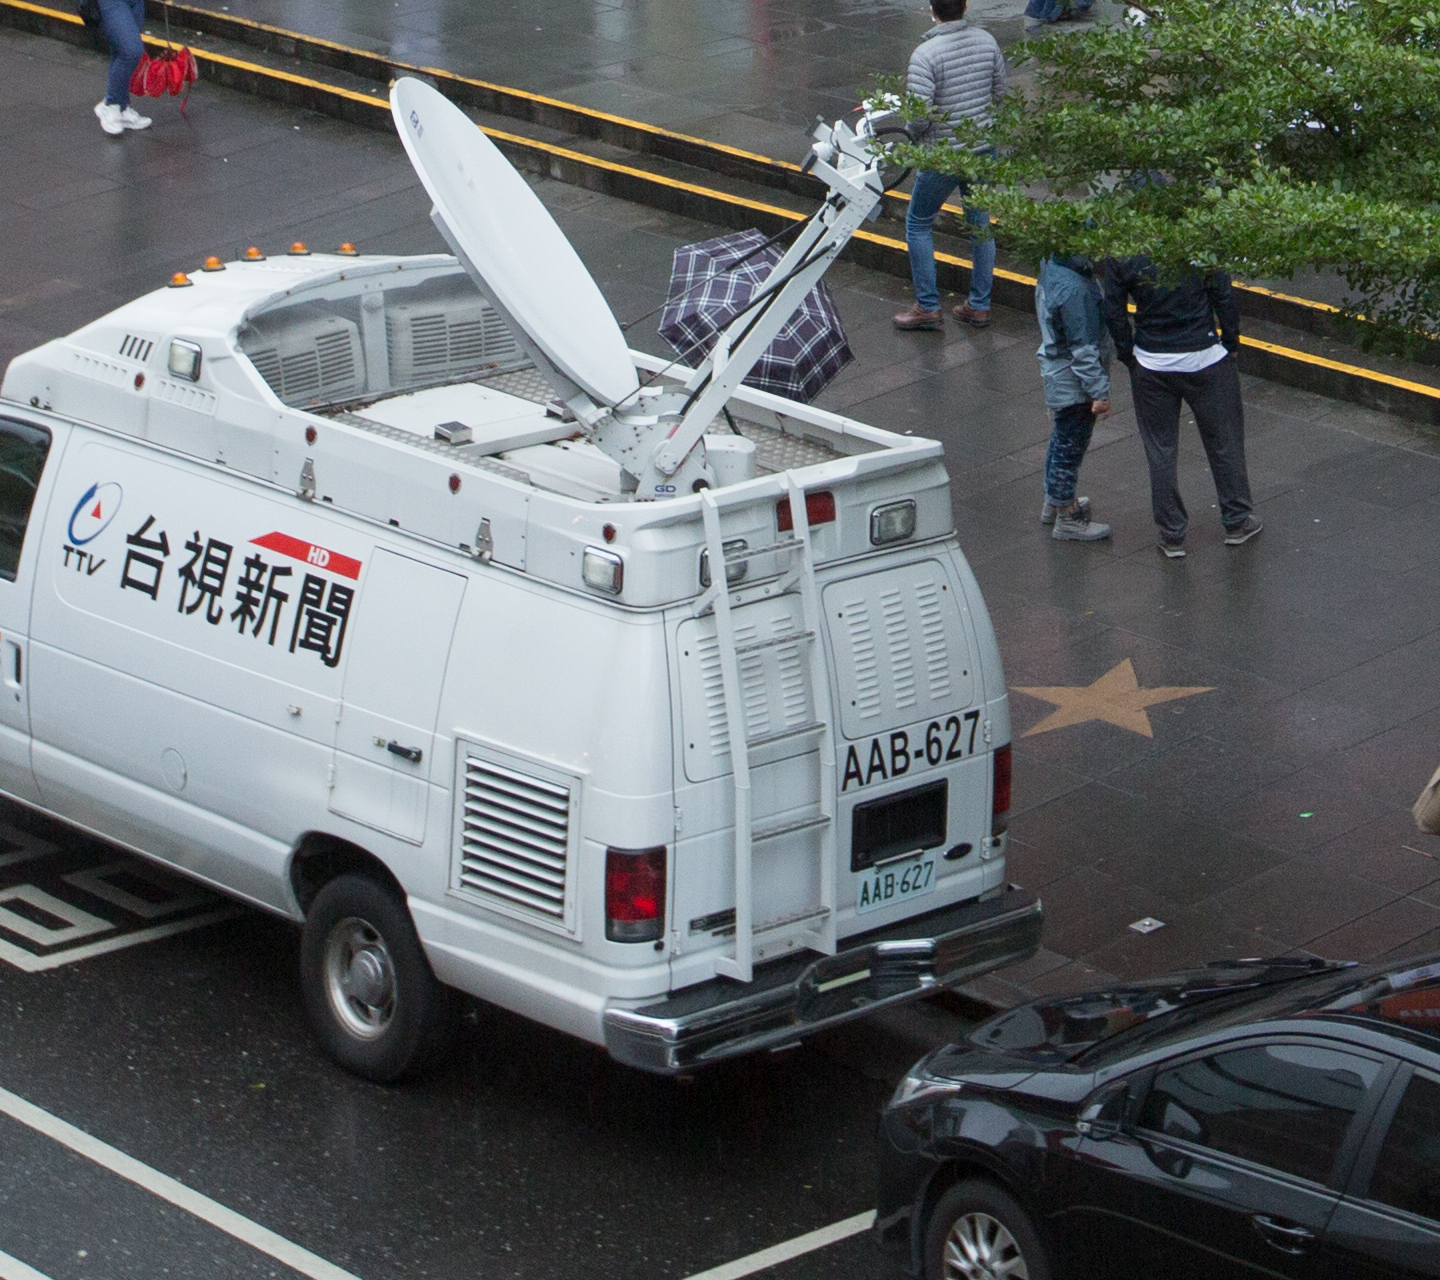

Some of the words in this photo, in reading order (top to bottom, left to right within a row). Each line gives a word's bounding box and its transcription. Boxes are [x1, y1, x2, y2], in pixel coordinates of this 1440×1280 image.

[63, 543, 107, 576] TTV
[307, 544, 330, 568] HD
[120, 514, 355, 668] 台視新聞
[841, 710, 981, 792] AAB-627
